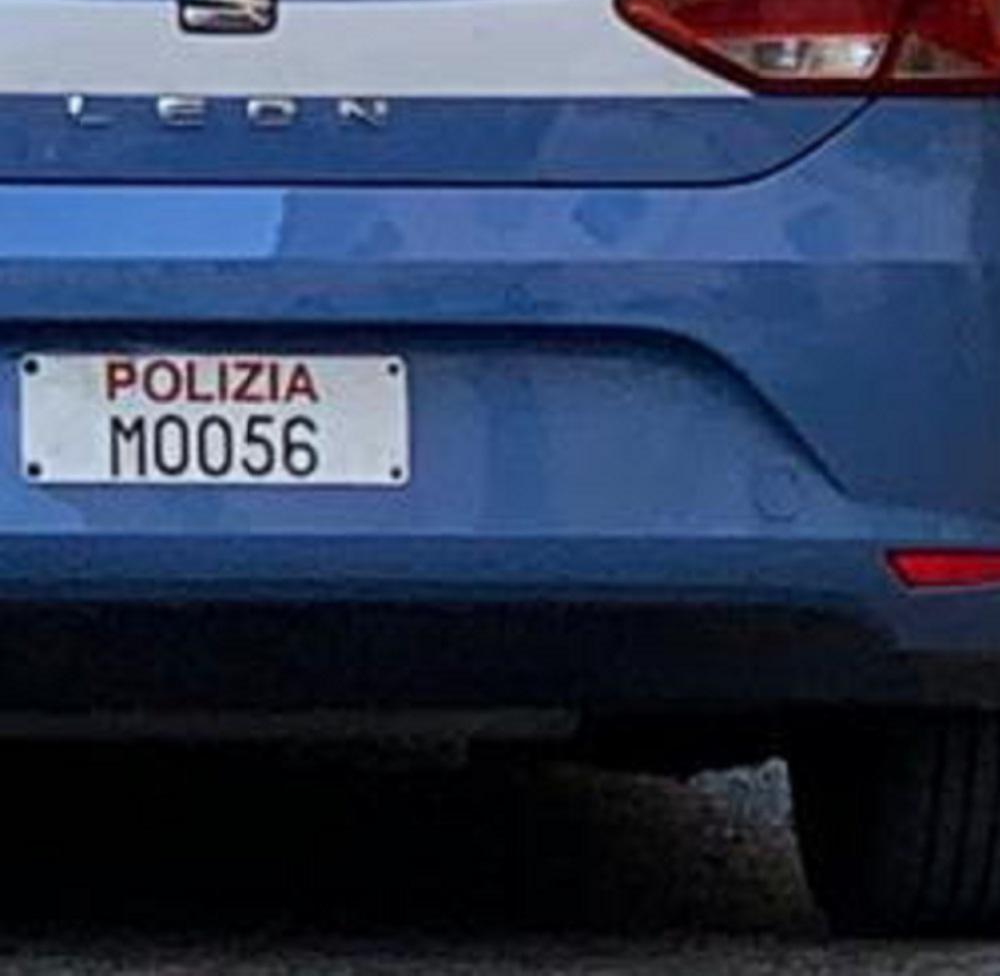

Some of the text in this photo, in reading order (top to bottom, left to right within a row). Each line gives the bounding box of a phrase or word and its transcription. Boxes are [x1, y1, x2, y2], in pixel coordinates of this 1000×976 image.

[66, 95, 388, 128] LEON
[106, 360, 319, 403] POLIZIA
[110, 414, 319, 477] M0056
